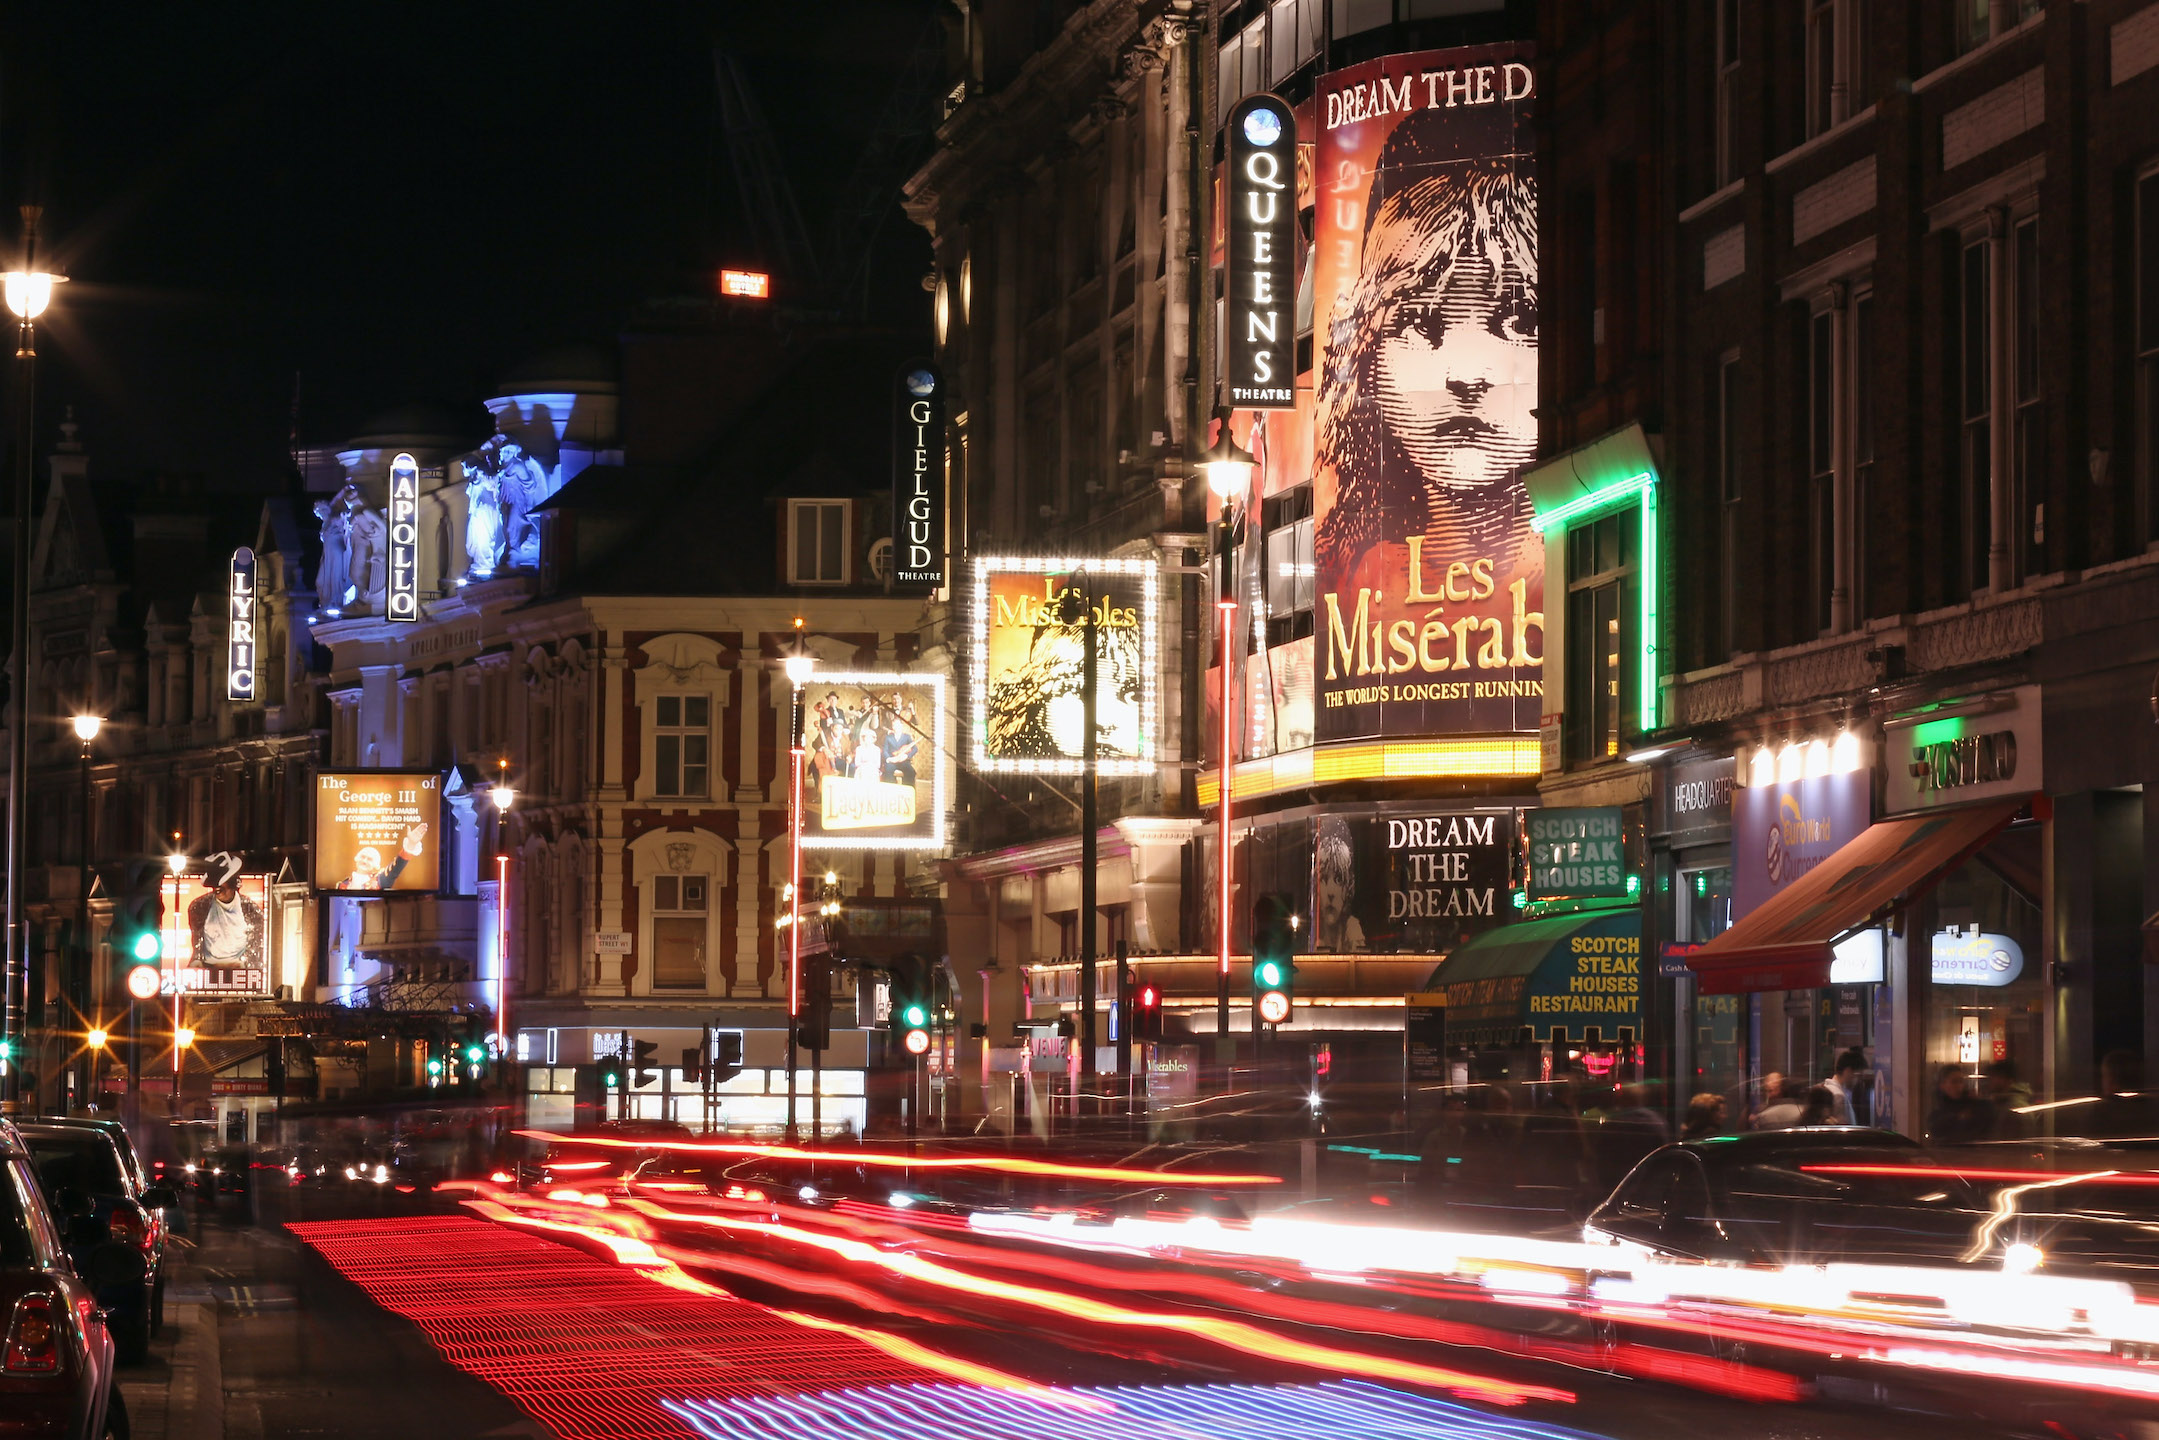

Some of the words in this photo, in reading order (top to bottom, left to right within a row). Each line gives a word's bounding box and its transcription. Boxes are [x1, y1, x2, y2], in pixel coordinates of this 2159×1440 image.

[1326, 75, 1413, 130] DREAM
[1421, 65, 1496, 110] THE
[1246, 151, 1286, 384] QUEENS
[1232, 388, 1292, 400] THEATRE
[909, 401, 932, 568] GIELGUD
[391, 477, 415, 614] APOLLO
[898, 571, 941, 581] THEATRE
[1404, 535, 1495, 604] Les
[231, 572, 253, 691] LYRIC
[1325, 691, 1344, 708] THE
[1345, 685, 1390, 706] WORLD'S
[1393, 682, 1470, 702] LONGEST
[320, 776, 348, 789] The
[421, 776, 437, 789] of
[339, 790, 392, 806] George
[398, 790, 416, 803] III
[381, 815, 402, 823] DAVID
[395, 807, 419, 815] SMASH
[1388, 817, 1495, 848] DREAM
[1533, 818, 1617, 840] SCOTCH
[1534, 842, 1617, 864] STEAK
[1409, 853, 1470, 883] THE
[1534, 866, 1620, 888] HOUSES
[1388, 888, 1495, 918] DREAM
[1571, 937, 1639, 953] SCOTCH
[1578, 957, 1639, 973] STEAK
[1570, 977, 1639, 993] HOUSES
[1530, 996, 1639, 1013] RESTAURANT
